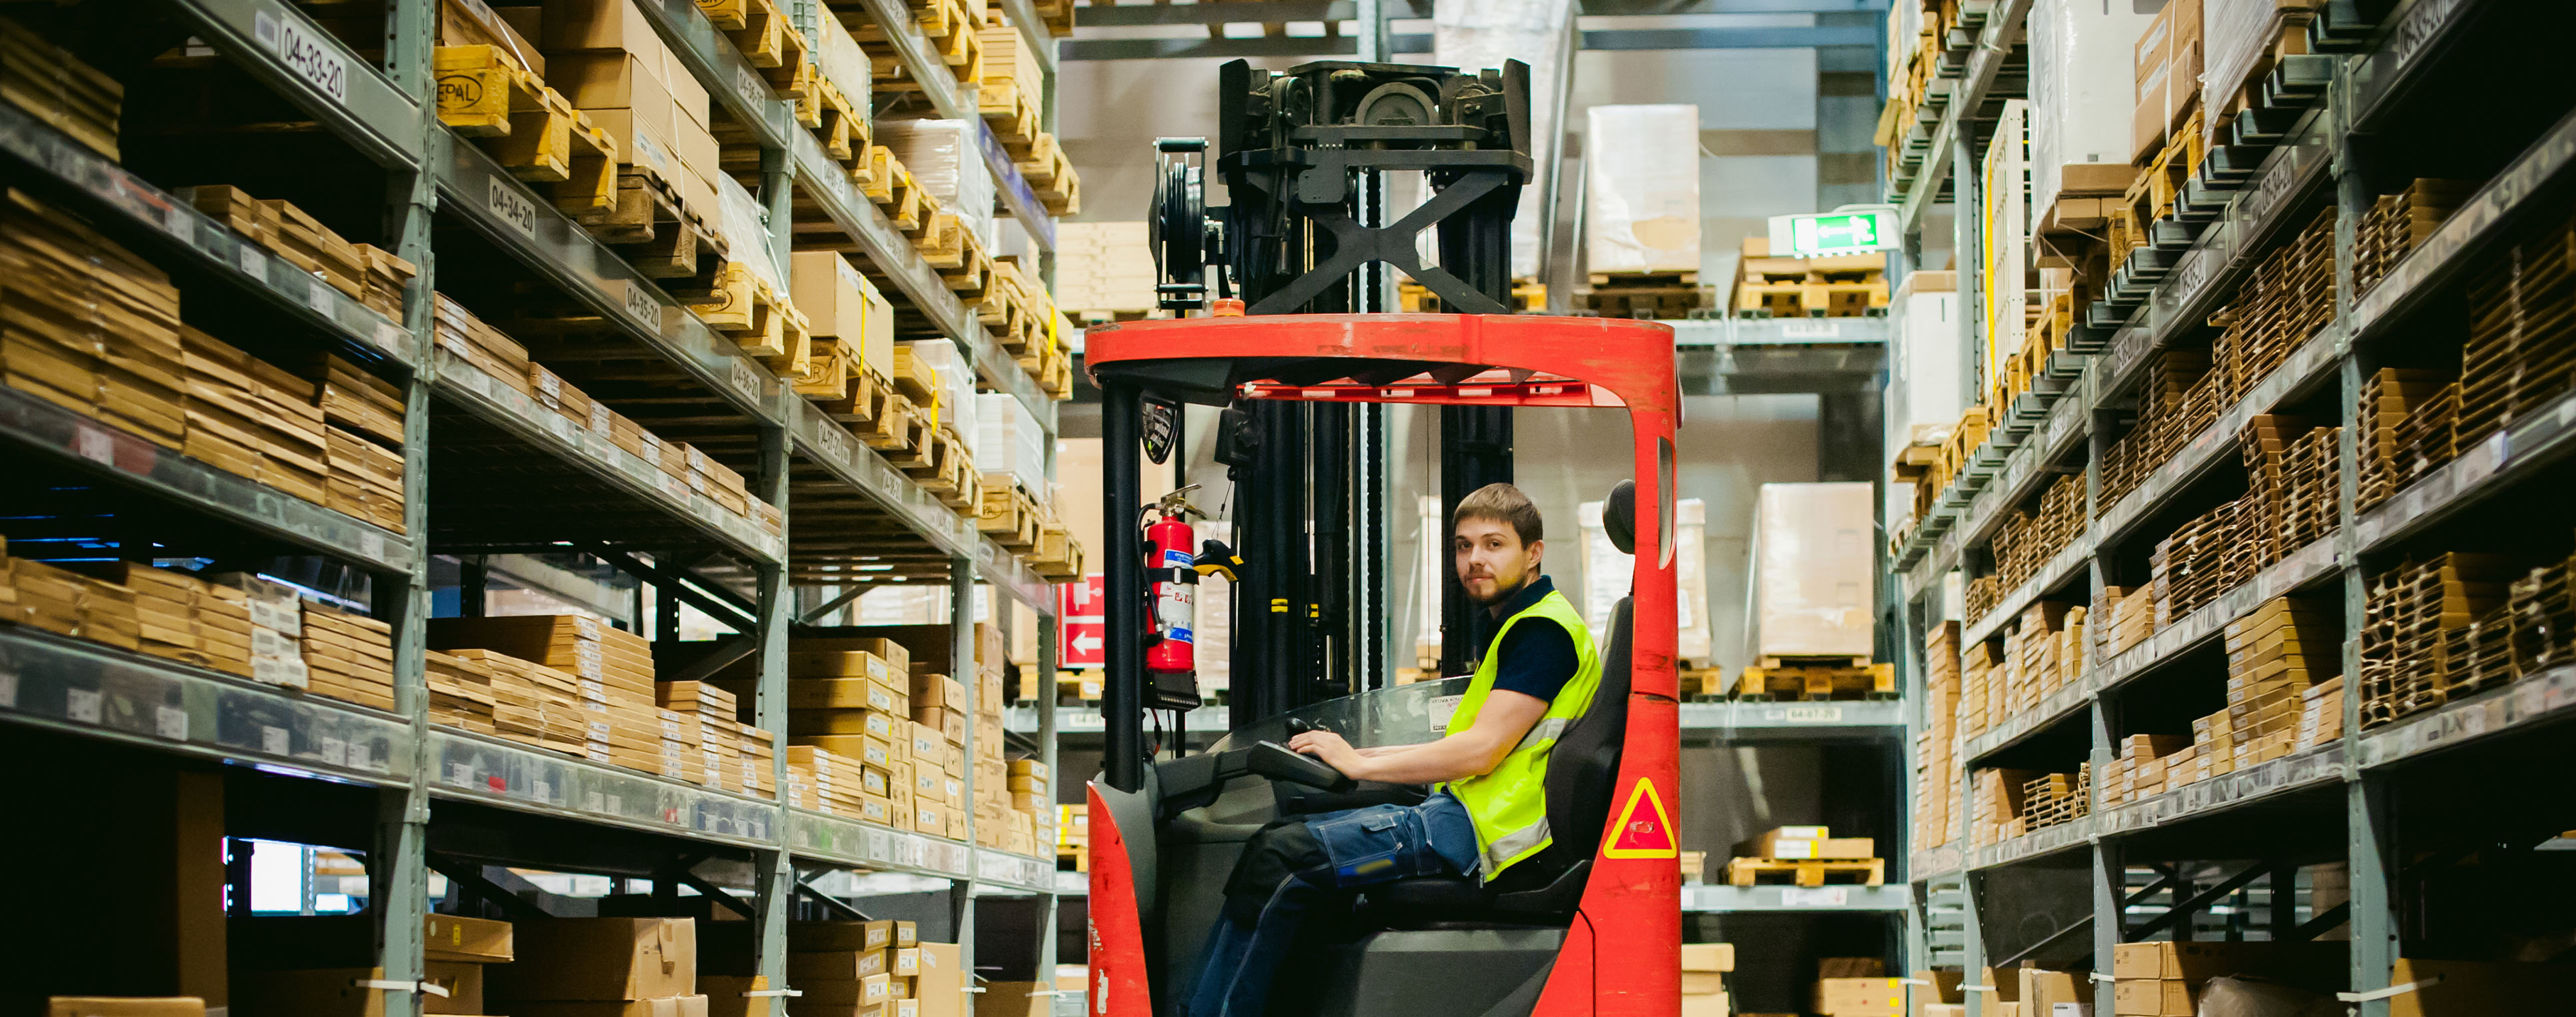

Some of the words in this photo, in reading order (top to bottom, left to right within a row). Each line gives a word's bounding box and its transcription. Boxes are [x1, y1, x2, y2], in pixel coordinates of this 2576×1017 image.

[285, 27, 343, 98] 04-33-20
[437, 84, 474, 102] EPAL
[493, 185, 533, 232] 04-34-20
[627, 287, 659, 328] 04-35-20
[733, 363, 758, 399] 04-36-20
